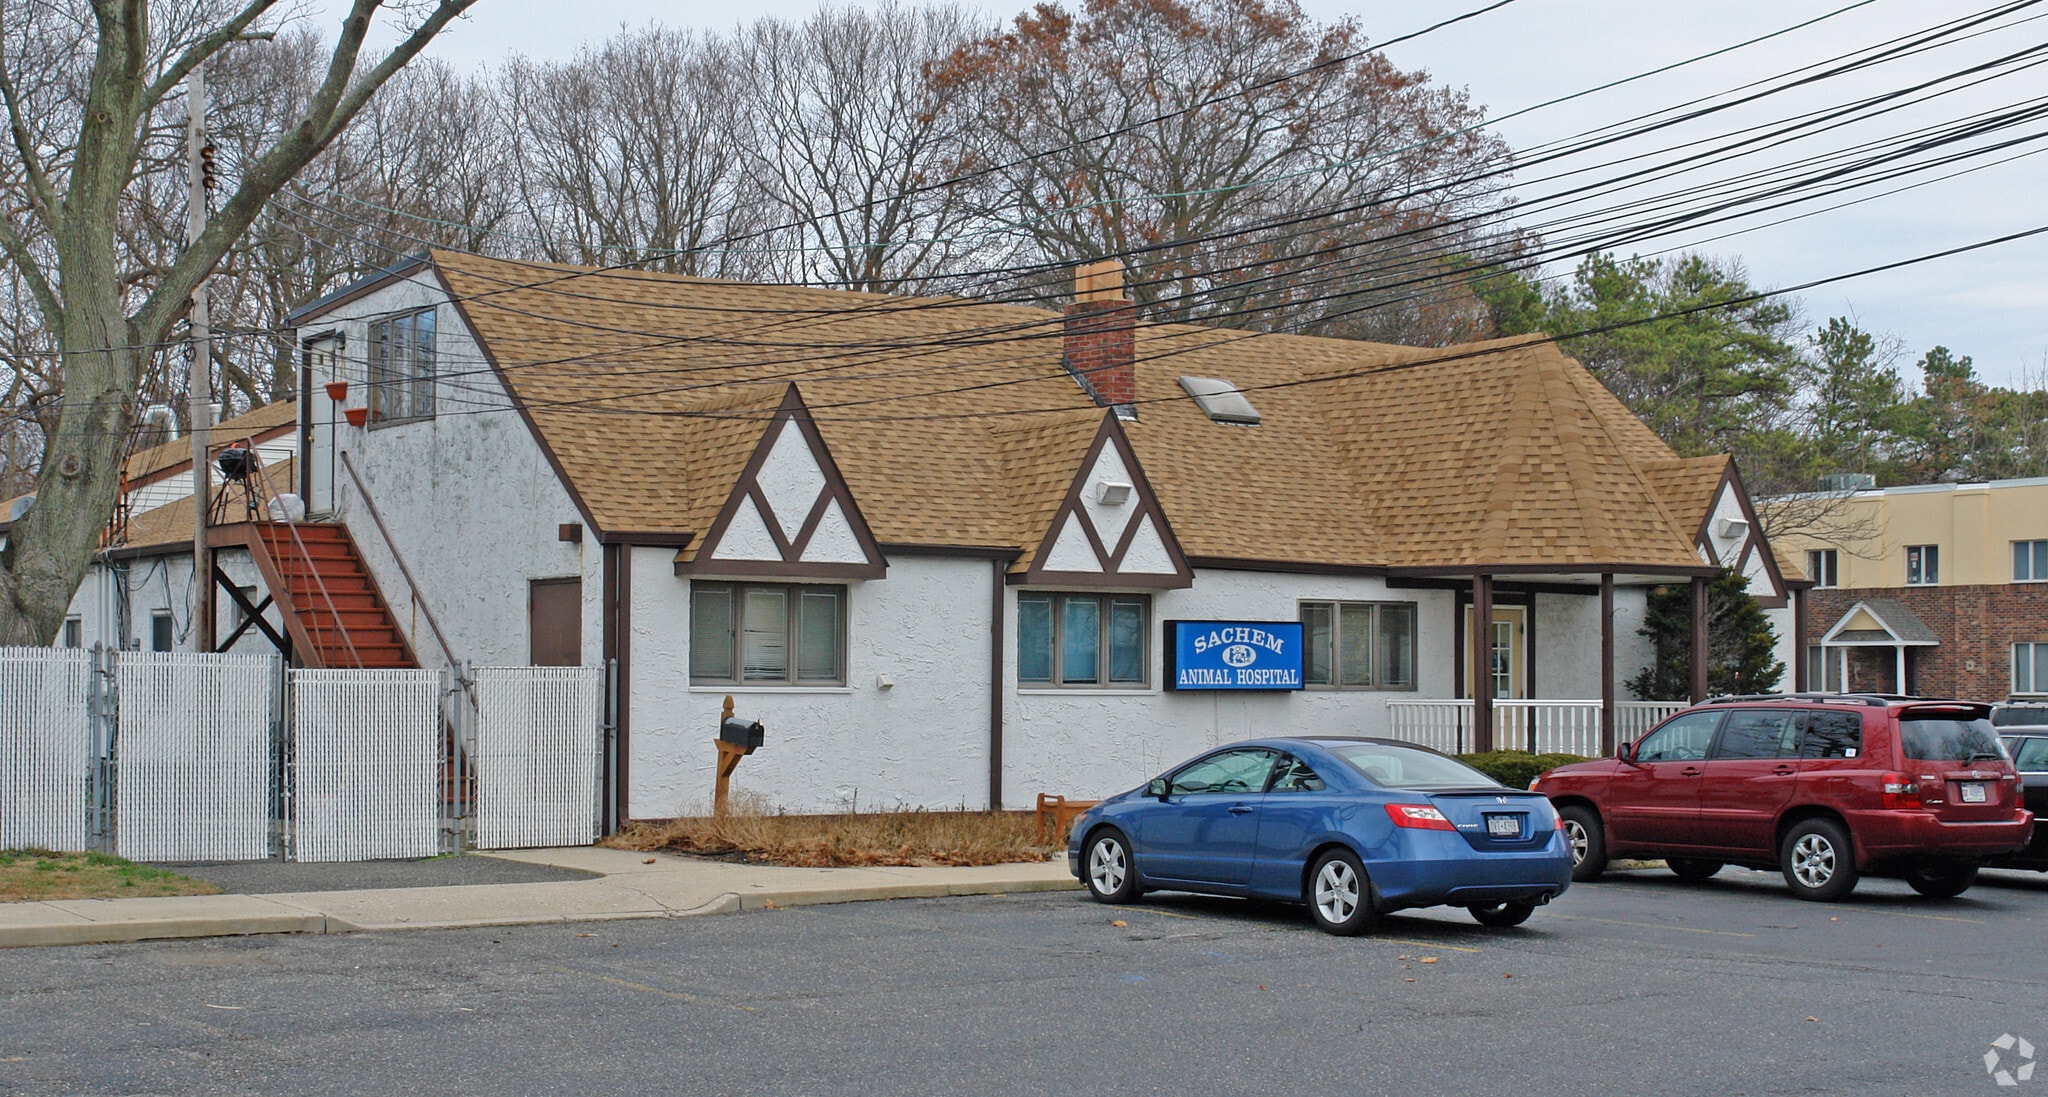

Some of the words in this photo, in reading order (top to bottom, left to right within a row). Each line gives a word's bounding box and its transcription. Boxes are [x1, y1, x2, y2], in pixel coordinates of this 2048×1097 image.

[1194, 627, 1284, 654] SACHEM
[1179, 669, 1232, 685] ANIMAL
[1237, 669, 1299, 685] HOSPITAL
